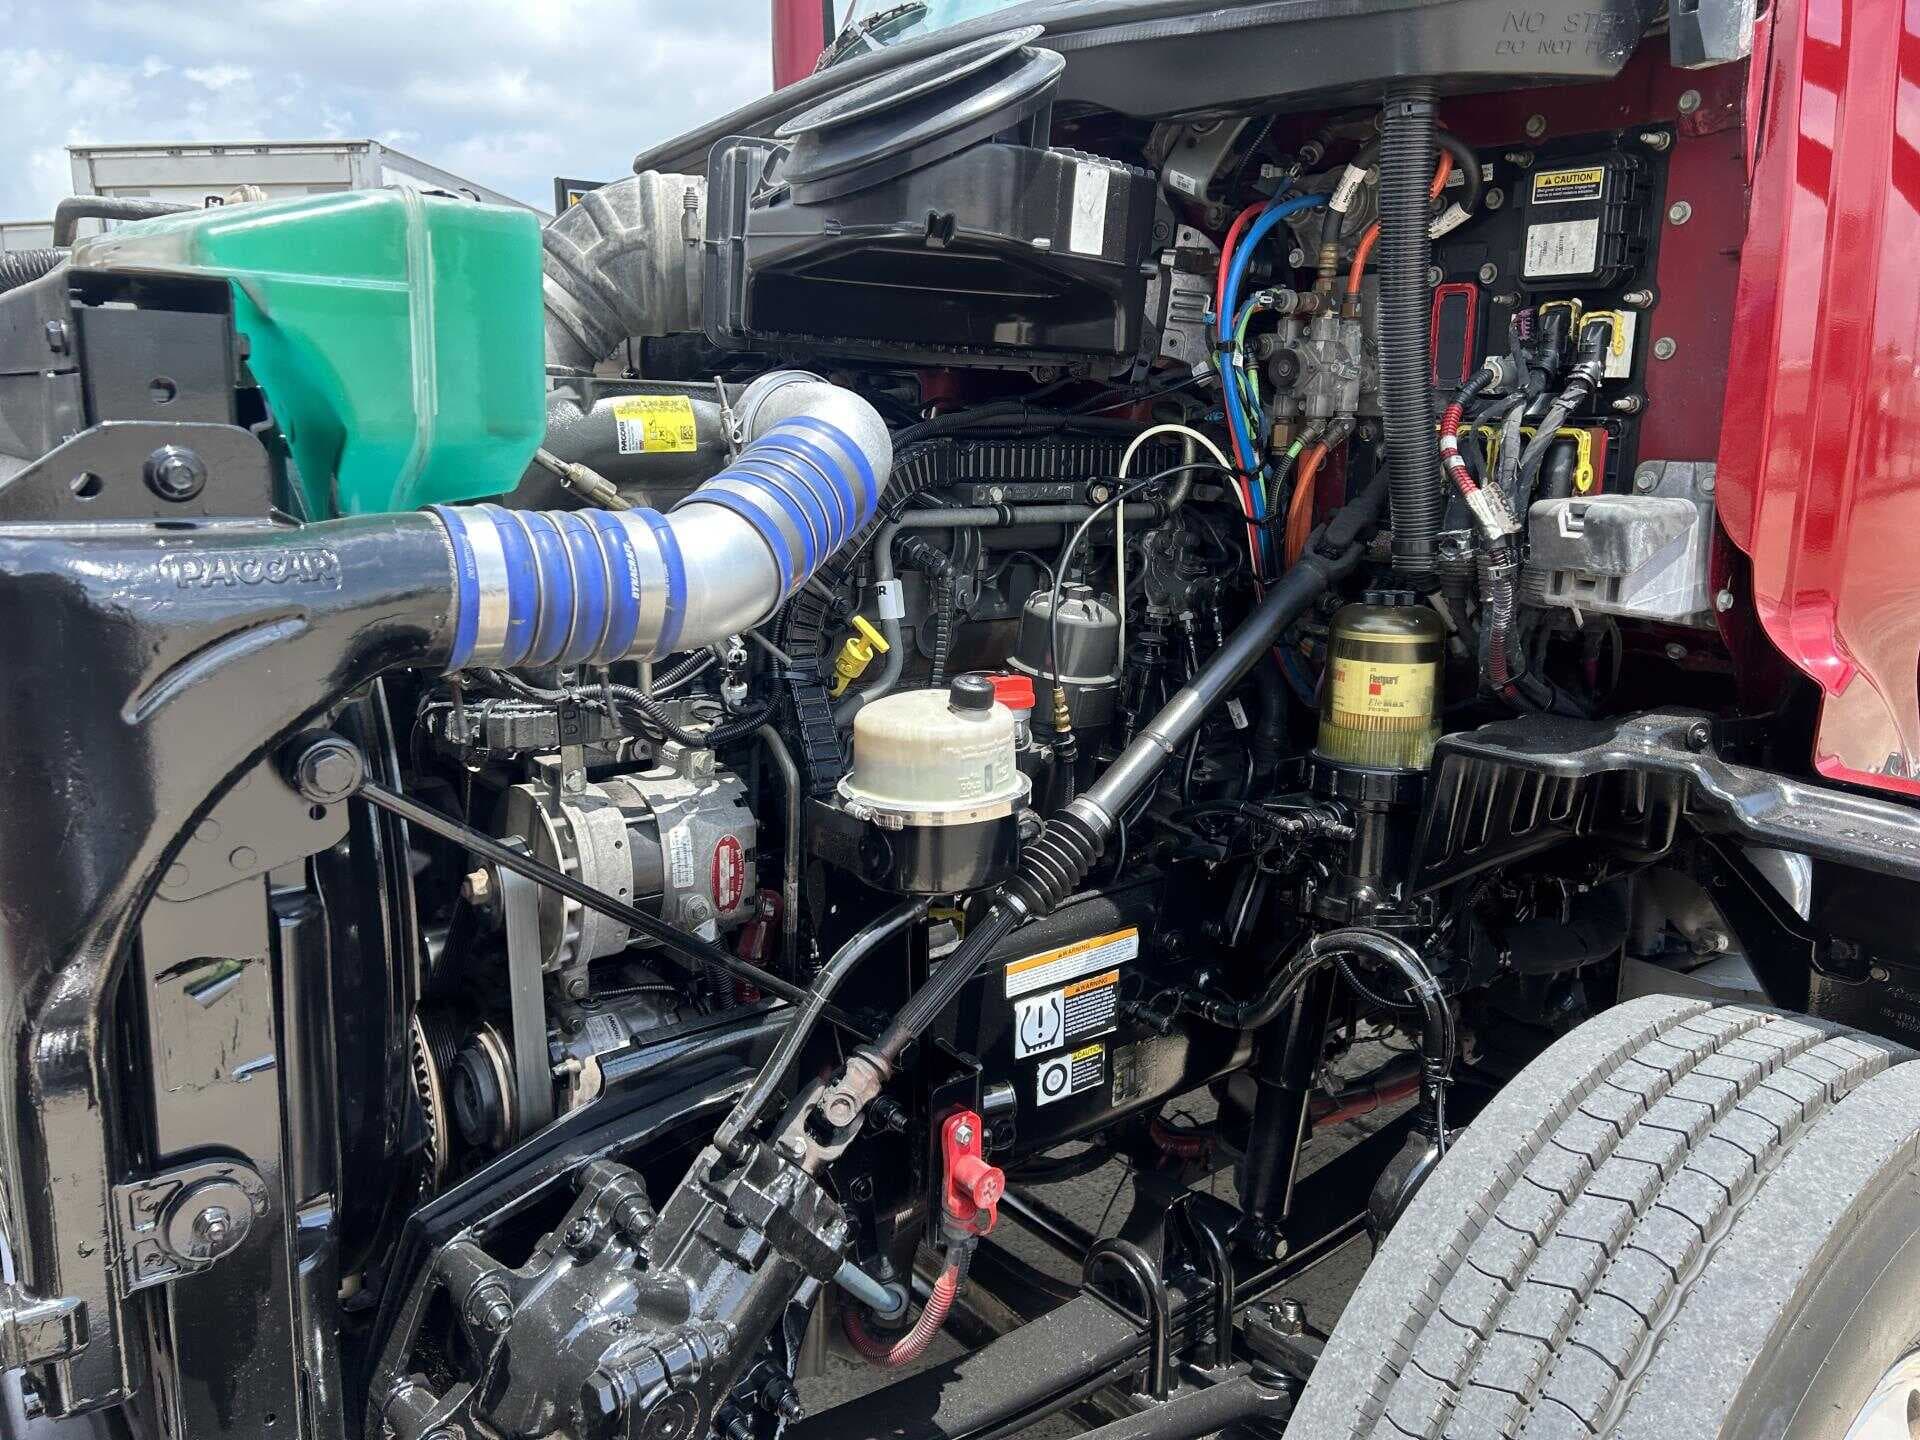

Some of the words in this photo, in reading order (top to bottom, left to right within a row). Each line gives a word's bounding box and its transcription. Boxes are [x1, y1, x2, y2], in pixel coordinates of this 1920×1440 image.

[1502, 9, 1545, 33] NO
[1495, 40, 1526, 55] DO
[1538, 40, 1573, 55] NOT
[1554, 173, 1594, 185] CAUTION
[173, 549, 338, 589] PACCAR
[1063, 943, 1091, 956] WARNING
[1080, 976, 1109, 991] WARNING
